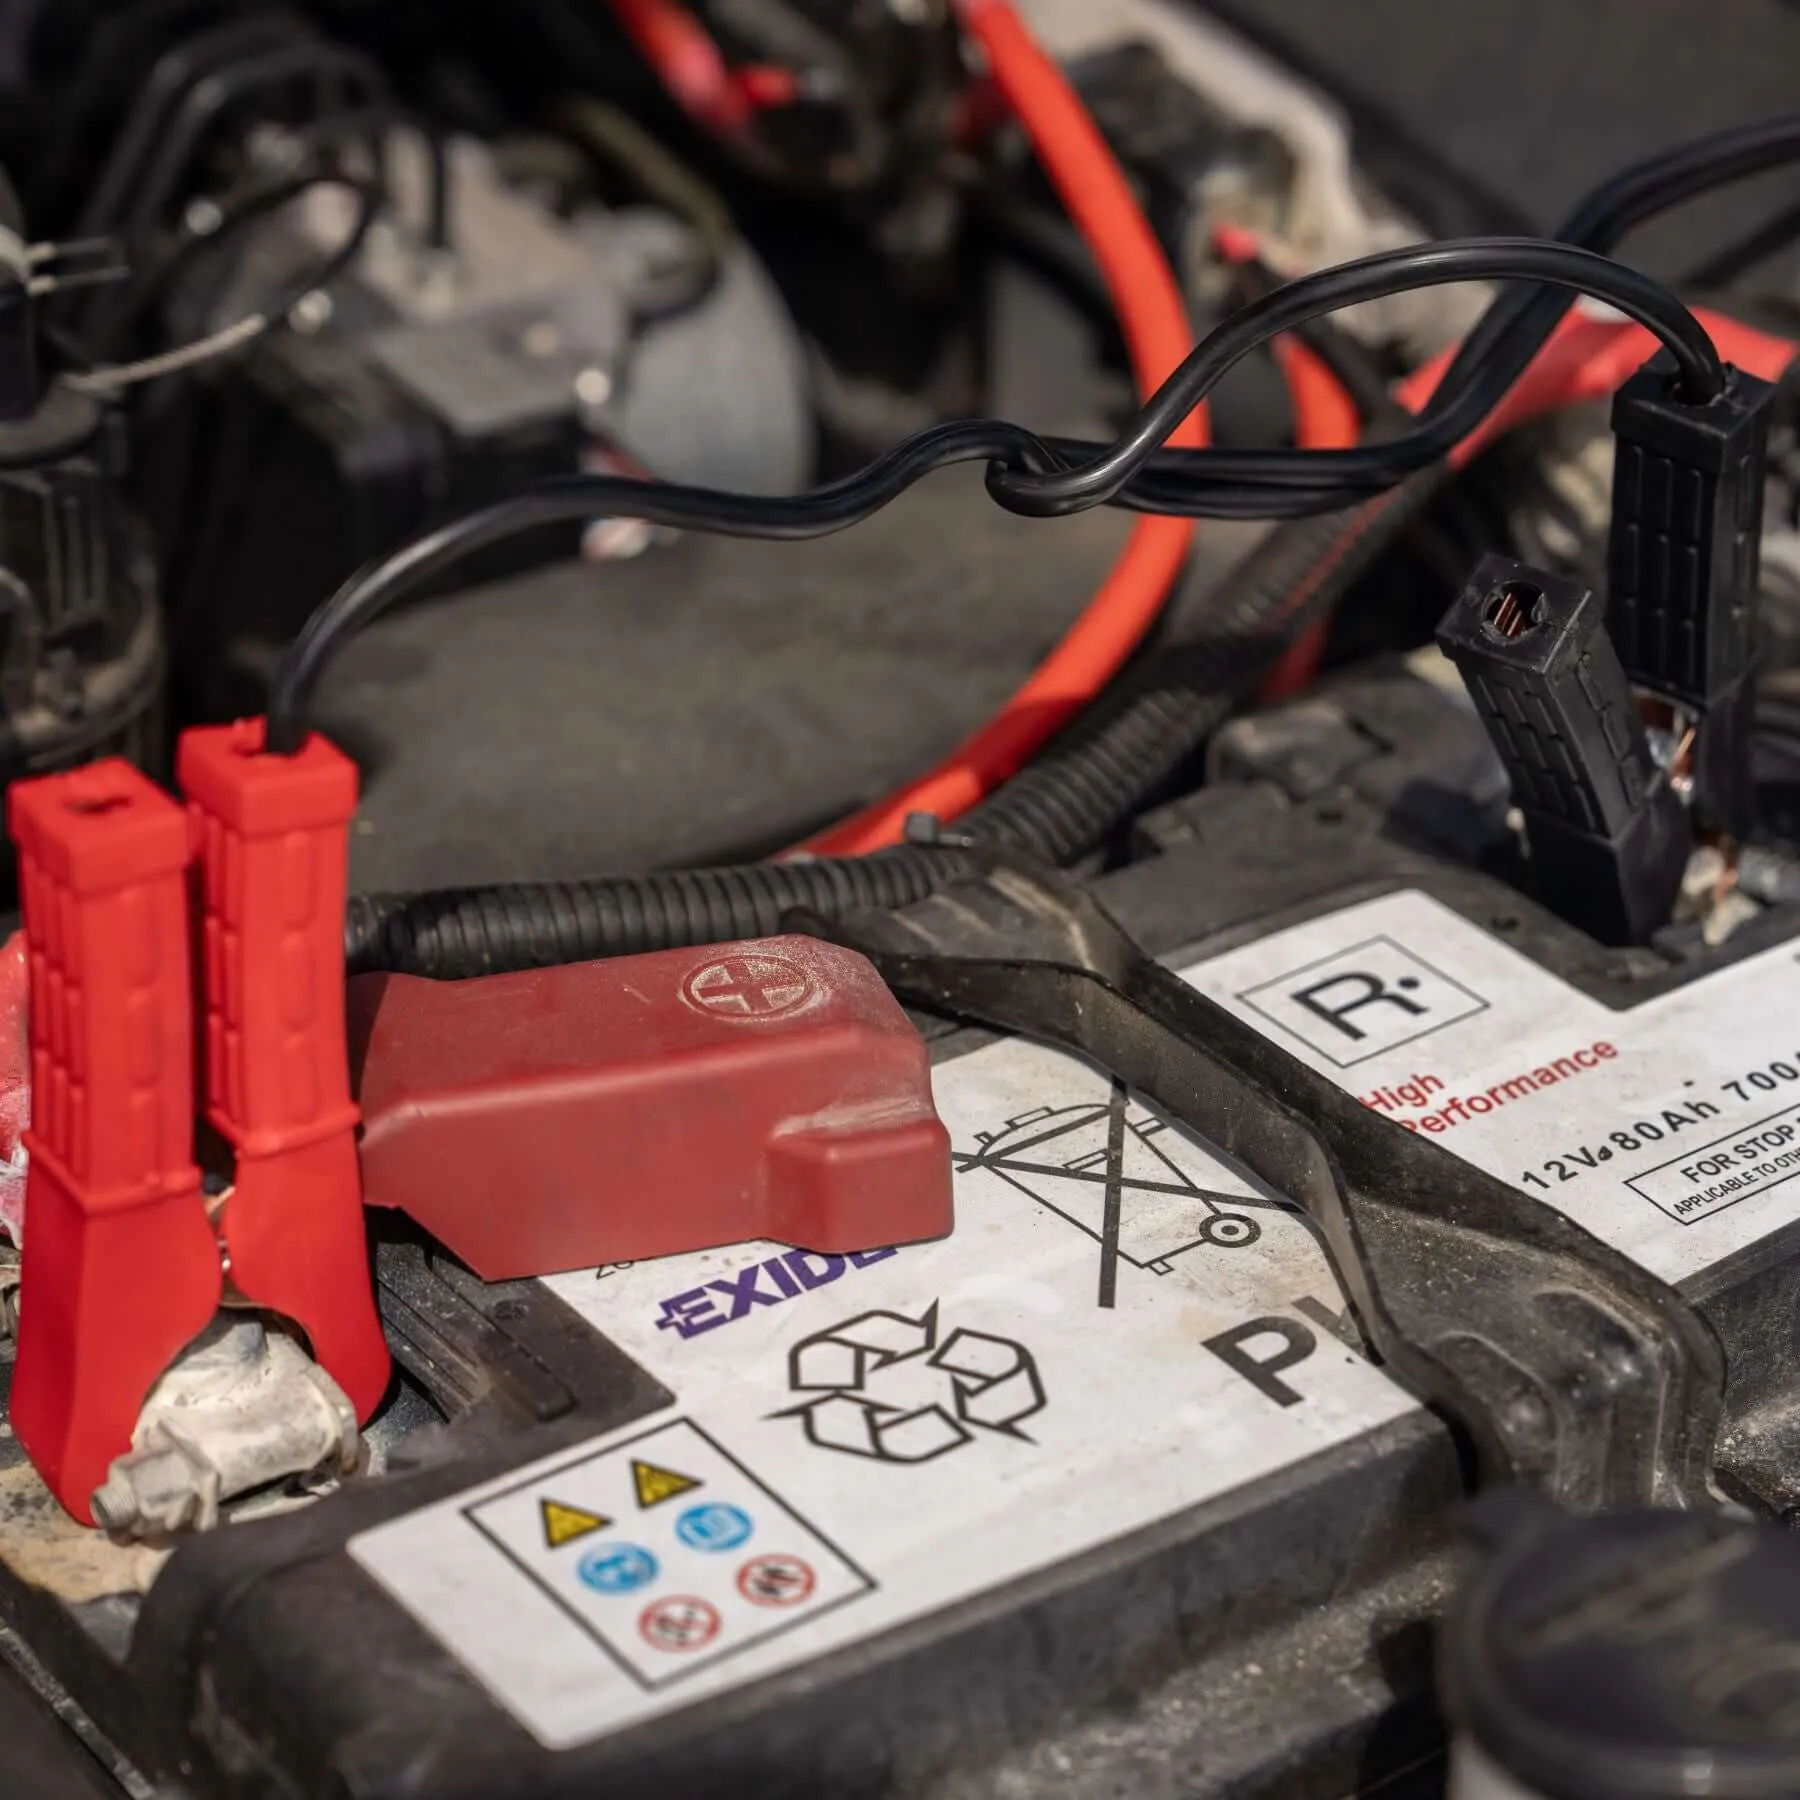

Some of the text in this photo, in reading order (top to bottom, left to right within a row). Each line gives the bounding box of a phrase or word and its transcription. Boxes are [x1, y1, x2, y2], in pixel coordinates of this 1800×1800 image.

[1359, 1073, 1445, 1111] High
[1609, 1101, 1721, 1151] 80Ah
[1720, 1052, 1800, 1101] 700
[1672, 1147, 1800, 1215] APPLICABLE TO OTH
[1680, 1124, 1795, 1184] FOR STOP
